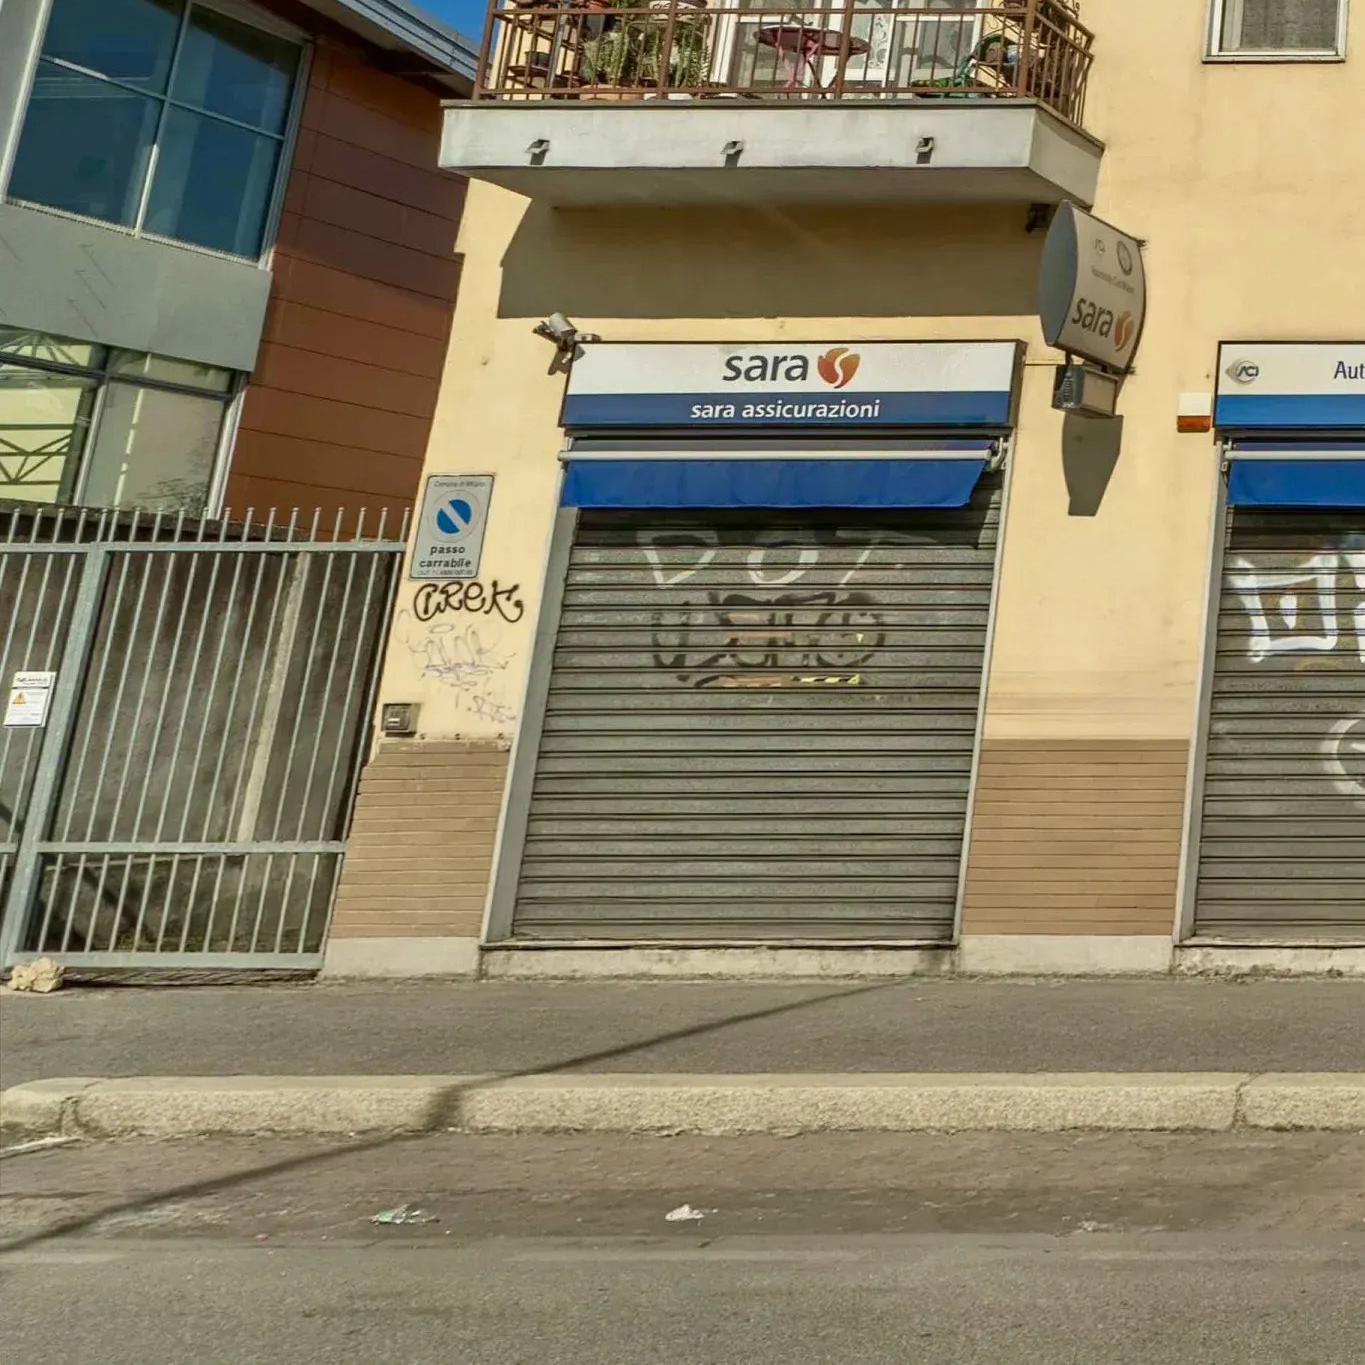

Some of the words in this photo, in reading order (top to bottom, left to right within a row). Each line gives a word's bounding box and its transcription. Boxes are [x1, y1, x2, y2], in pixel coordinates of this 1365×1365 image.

[1071, 297, 1114, 339] sara
[722, 352, 809, 382] sara
[690, 401, 735, 419] sara
[741, 399, 880, 419] assicurazioni
[430, 545, 466, 555] passo
[419, 557, 472, 568] carrabile
